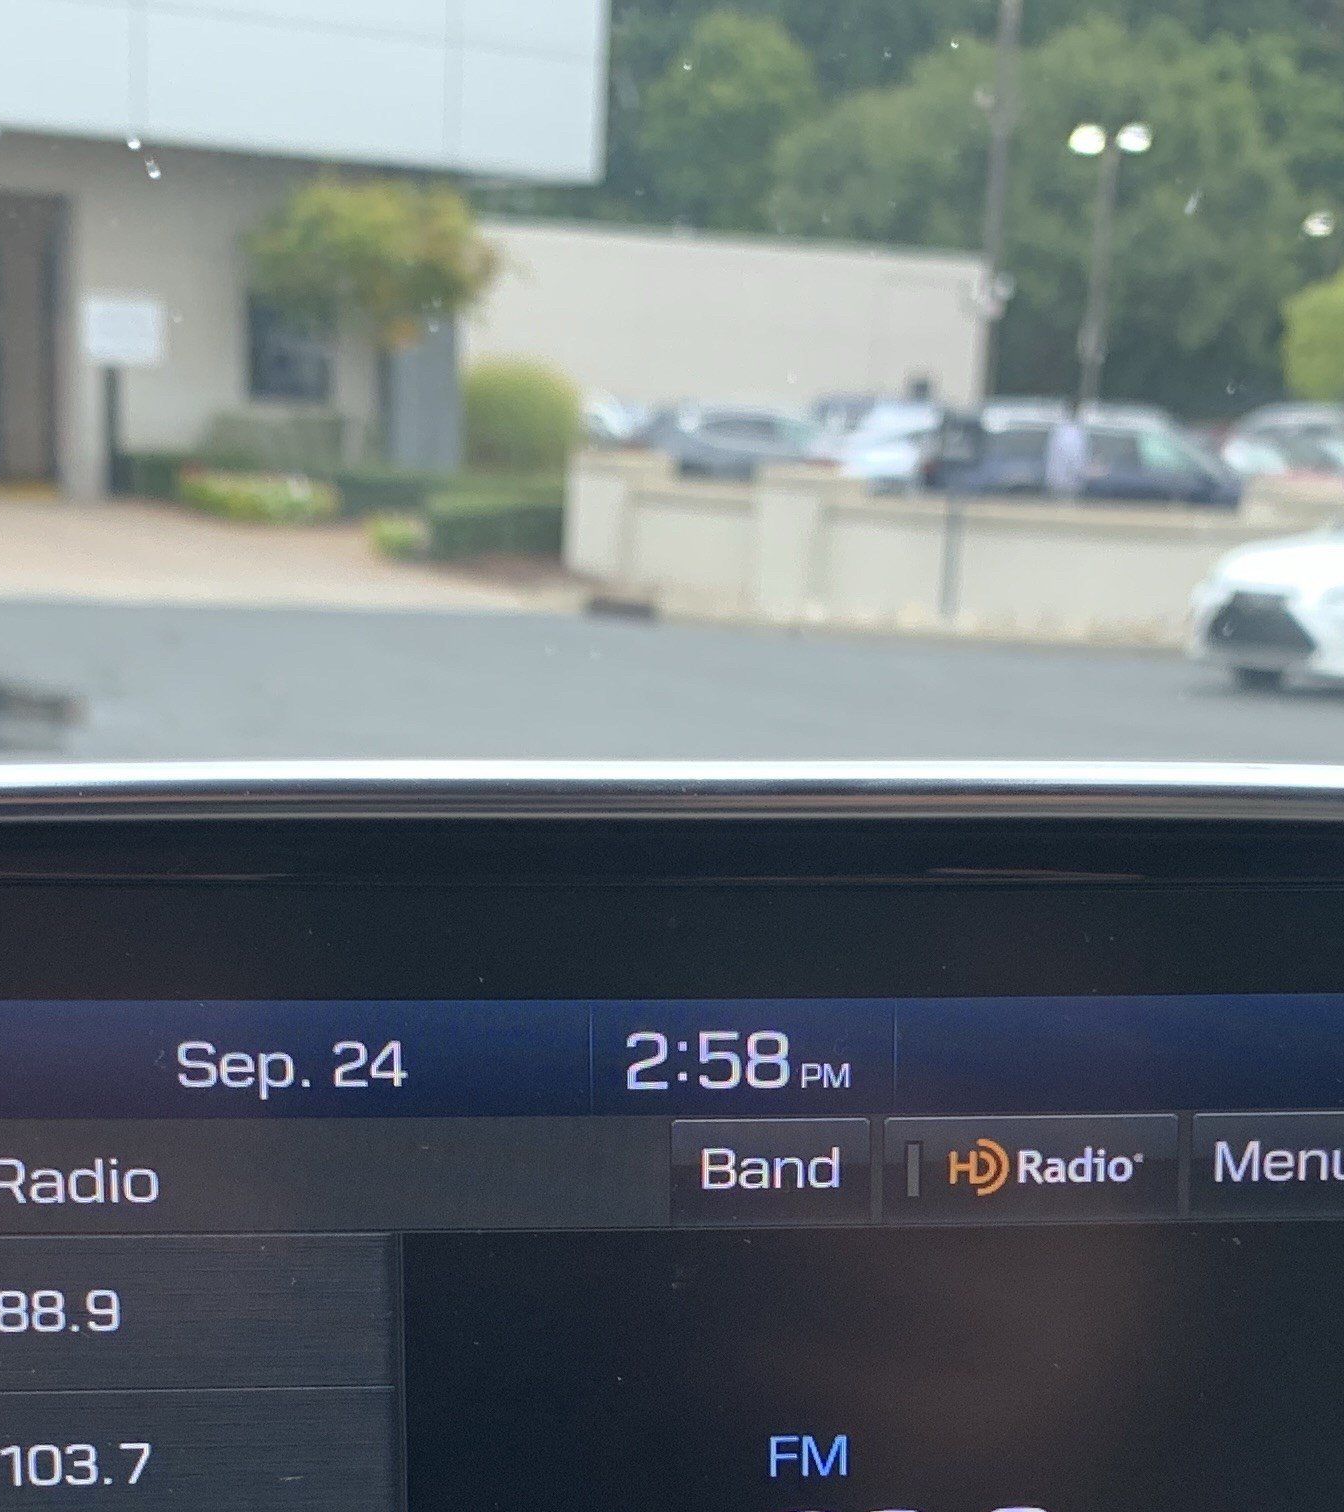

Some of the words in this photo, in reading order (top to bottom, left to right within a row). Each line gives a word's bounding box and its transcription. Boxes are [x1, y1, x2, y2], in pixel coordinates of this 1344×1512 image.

[177, 1040, 311, 1100] Sep.
[333, 1040, 408, 1088] 24
[626, 1030, 790, 1090] 2:58
[801, 1062, 851, 1088] PM
[701, 1146, 840, 1190] Band
[949, 1138, 1010, 1196] HD
[1018, 1146, 1143, 1184] Radio
[0, 1442, 151, 1487] 103.7
[769, 1434, 848, 1478] FM
